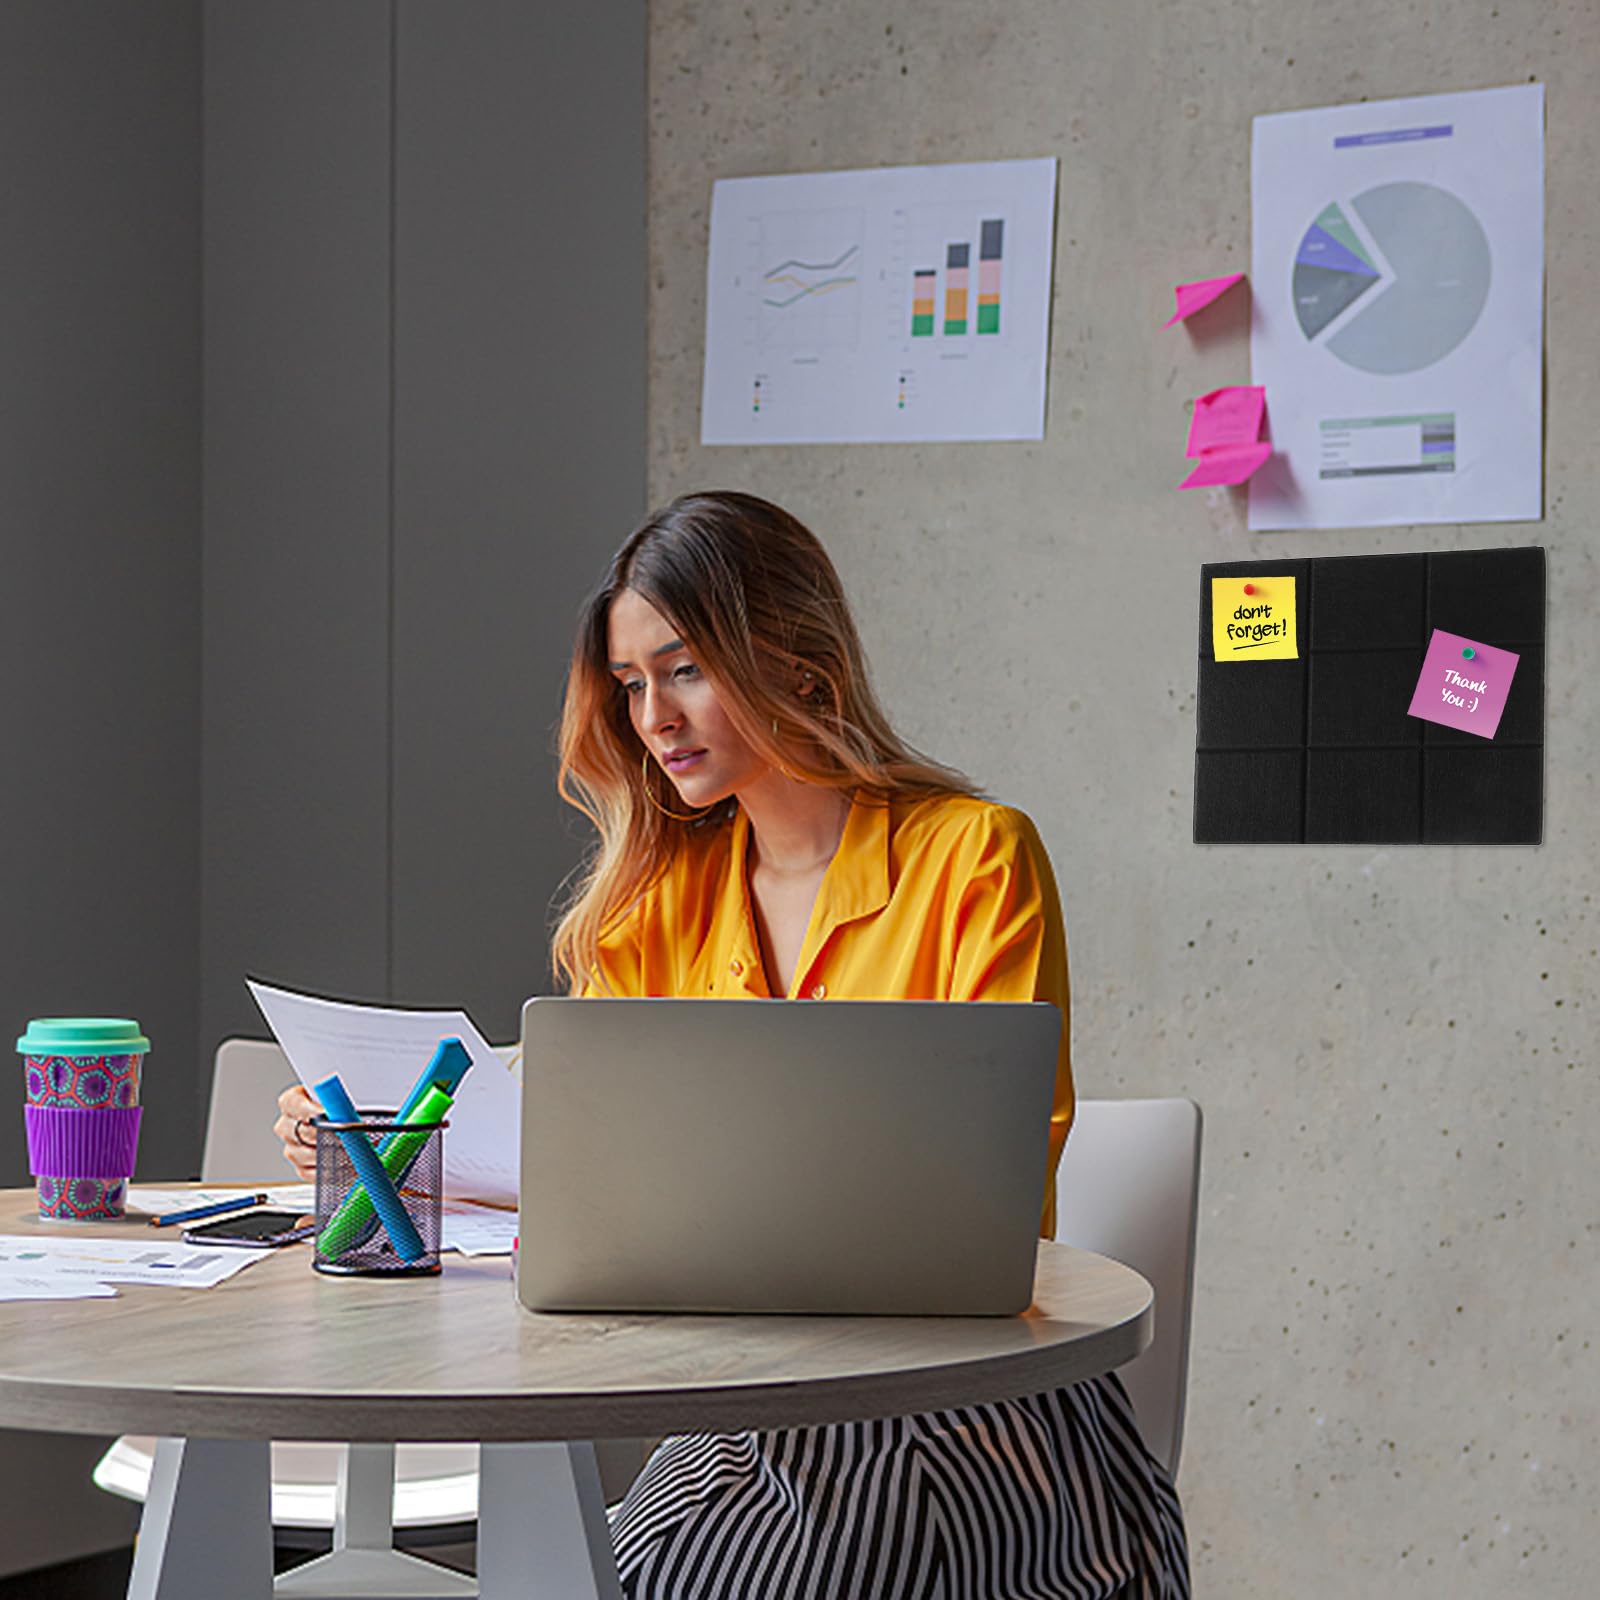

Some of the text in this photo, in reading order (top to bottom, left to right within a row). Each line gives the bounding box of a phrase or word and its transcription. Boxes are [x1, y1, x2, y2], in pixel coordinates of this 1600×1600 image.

[1233, 604, 1273, 620] don't
[1226, 618, 1287, 642] forget!
[1444, 669, 1488, 695] Thank
[1441, 687, 1465, 708] You
